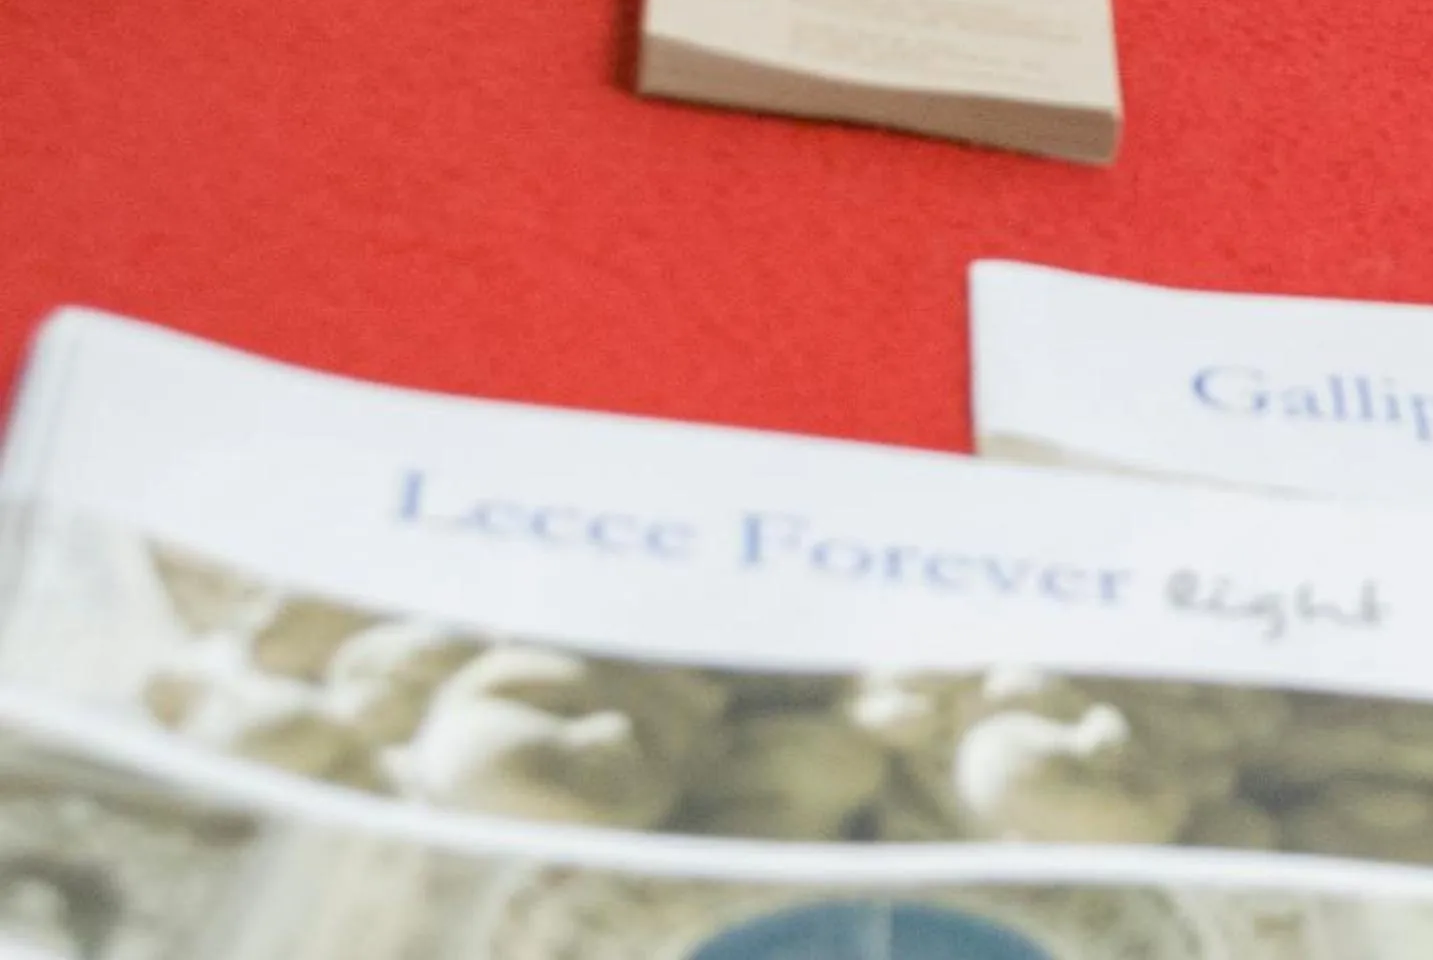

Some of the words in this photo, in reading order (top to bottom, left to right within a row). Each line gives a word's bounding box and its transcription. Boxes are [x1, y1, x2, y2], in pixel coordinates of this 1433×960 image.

[396, 467, 700, 562] Lecce
[740, 512, 1131, 606] Forever
[1164, 566, 1391, 641] light
